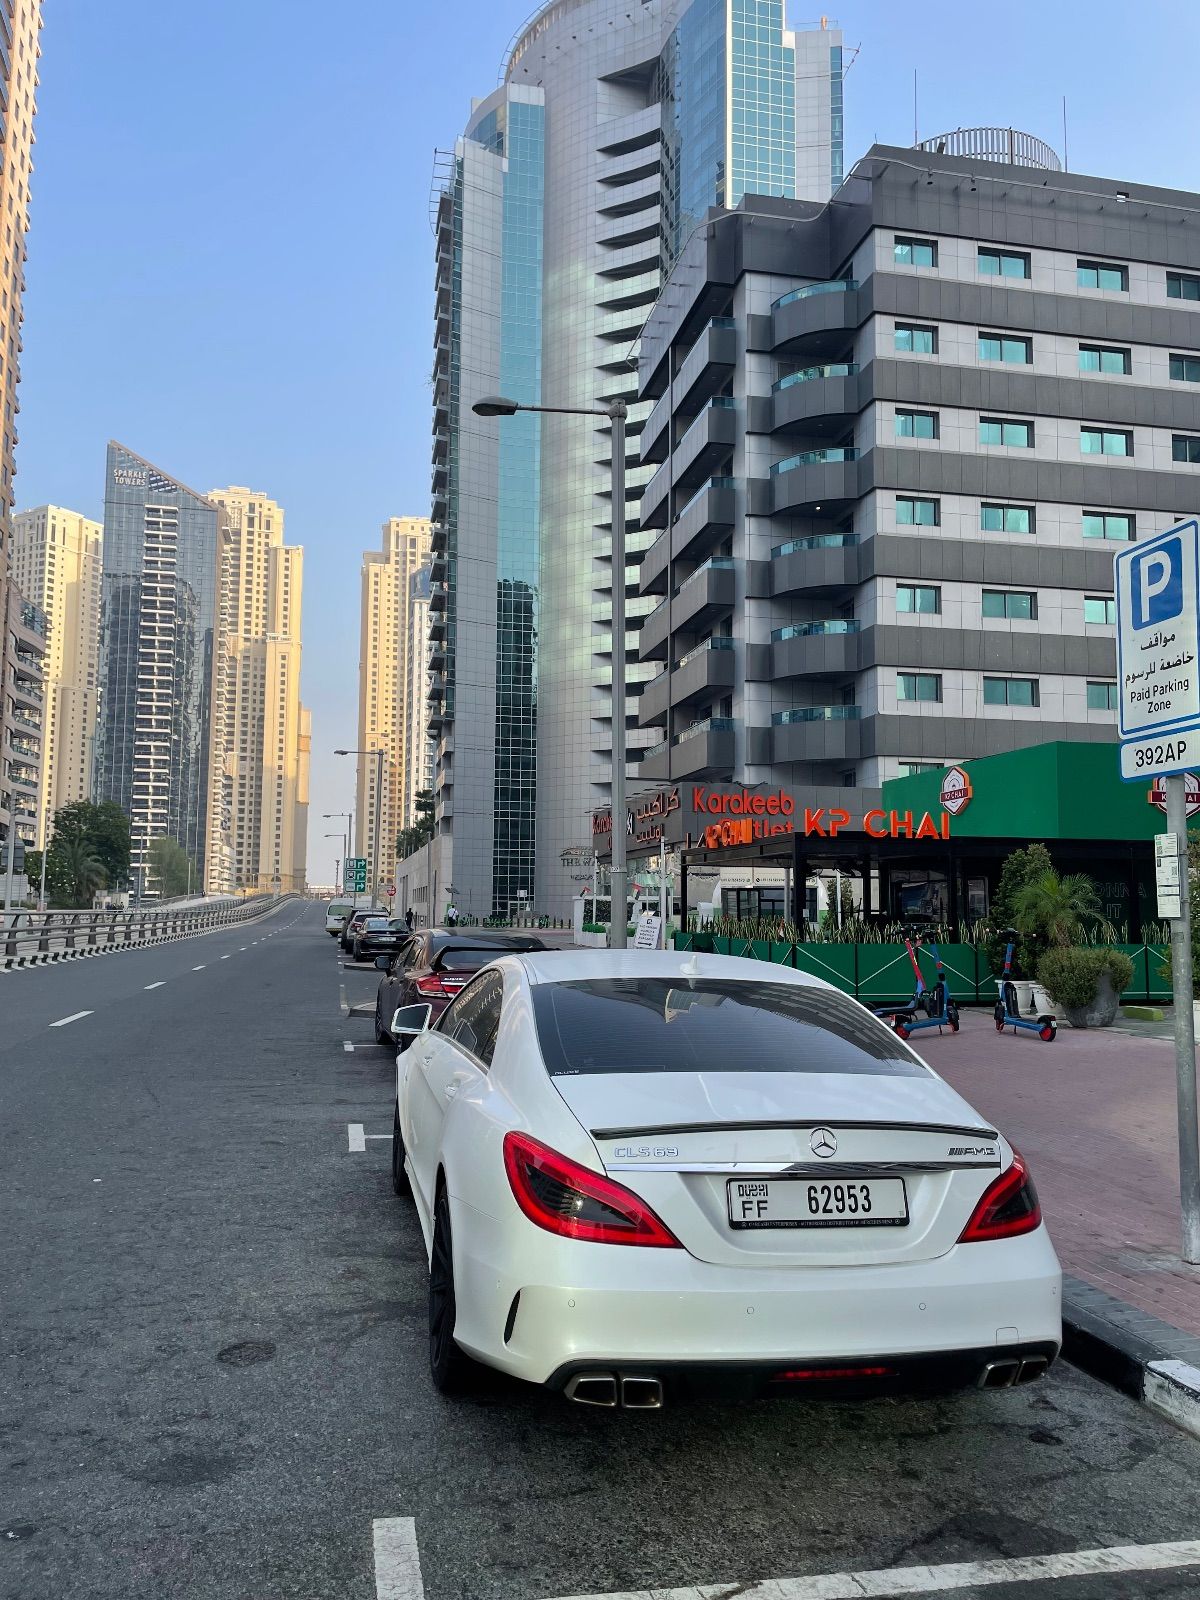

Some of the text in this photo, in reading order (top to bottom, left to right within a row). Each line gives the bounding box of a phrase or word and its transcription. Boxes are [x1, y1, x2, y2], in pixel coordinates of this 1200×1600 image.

[113, 469, 147, 479] SPARKLE
[115, 476, 146, 486] TOWERS
[1140, 550, 1172, 624] P
[1140, 632, 1176, 651] مواقف
[1125, 651, 1195, 689] خاضعة للرسوم
[1130, 678, 1189, 703] Paid Parking
[1147, 700, 1172, 714] Zone
[1135, 740, 1187, 768] 392AP
[693, 786, 795, 815] Karakeeb
[804, 808, 950, 840] KP CHAI
[614, 1147, 679, 1158] CLS 63
[742, 1200, 768, 1218] FF
[807, 1184, 872, 1214] 62953
